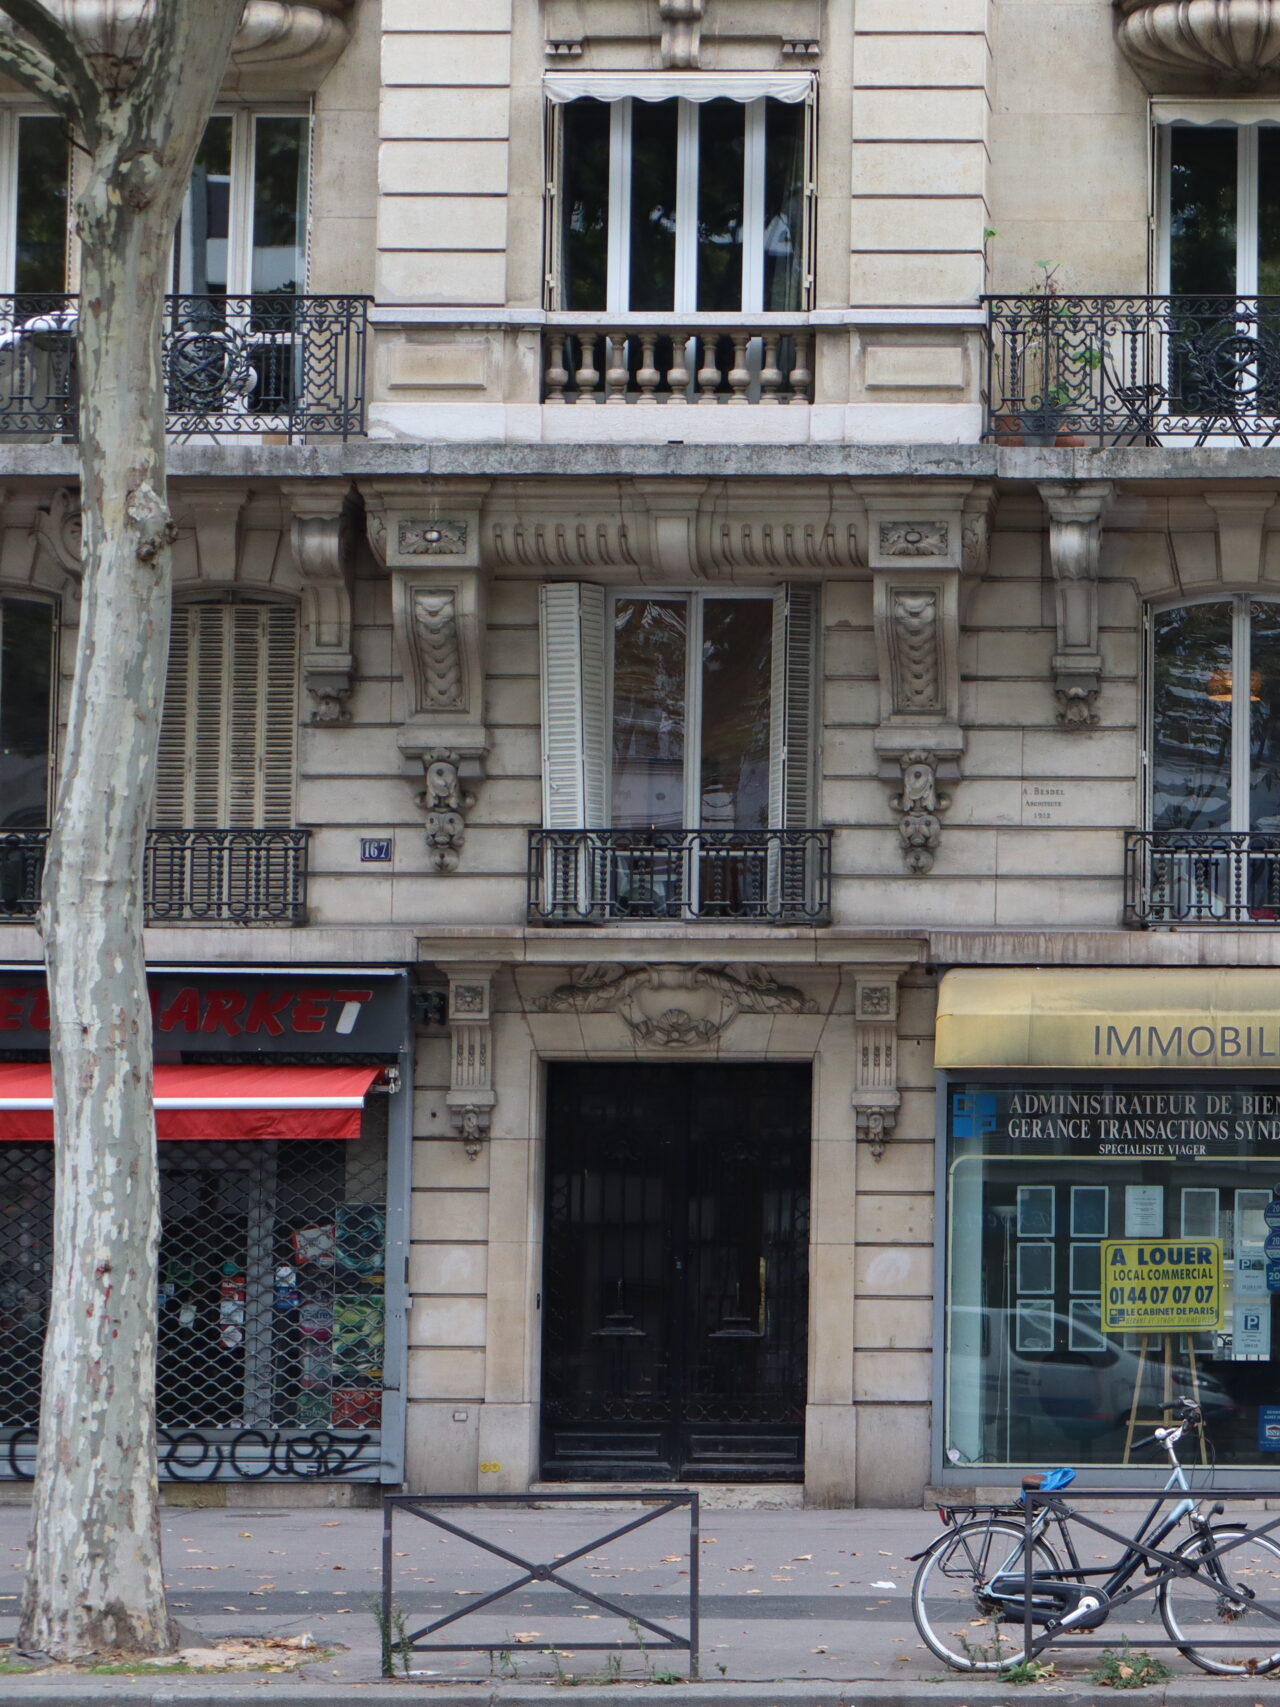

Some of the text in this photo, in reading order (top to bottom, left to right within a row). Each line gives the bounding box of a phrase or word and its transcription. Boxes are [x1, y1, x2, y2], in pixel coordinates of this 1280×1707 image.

[364, 841, 388, 858] 167
[153, 987, 373, 1036] ARKET
[1009, 1094, 1197, 1115] ADMINISTRATEUR
[1206, 1095, 1233, 1115] DE
[1008, 1118, 1091, 1139] GERANCE
[1098, 1119, 1229, 1140] TRANSACTIONS
[1098, 1143, 1206, 1156] SPECIALISTE VIAGER
[1110, 1247, 1213, 1266] A LOUER
[1113, 1268, 1214, 1281] LOCAL COMMERCIAL
[1109, 1285, 1214, 1305] 01 44 07 07 07
[1126, 1306, 1215, 1316] LE CABINET DE PARIS
